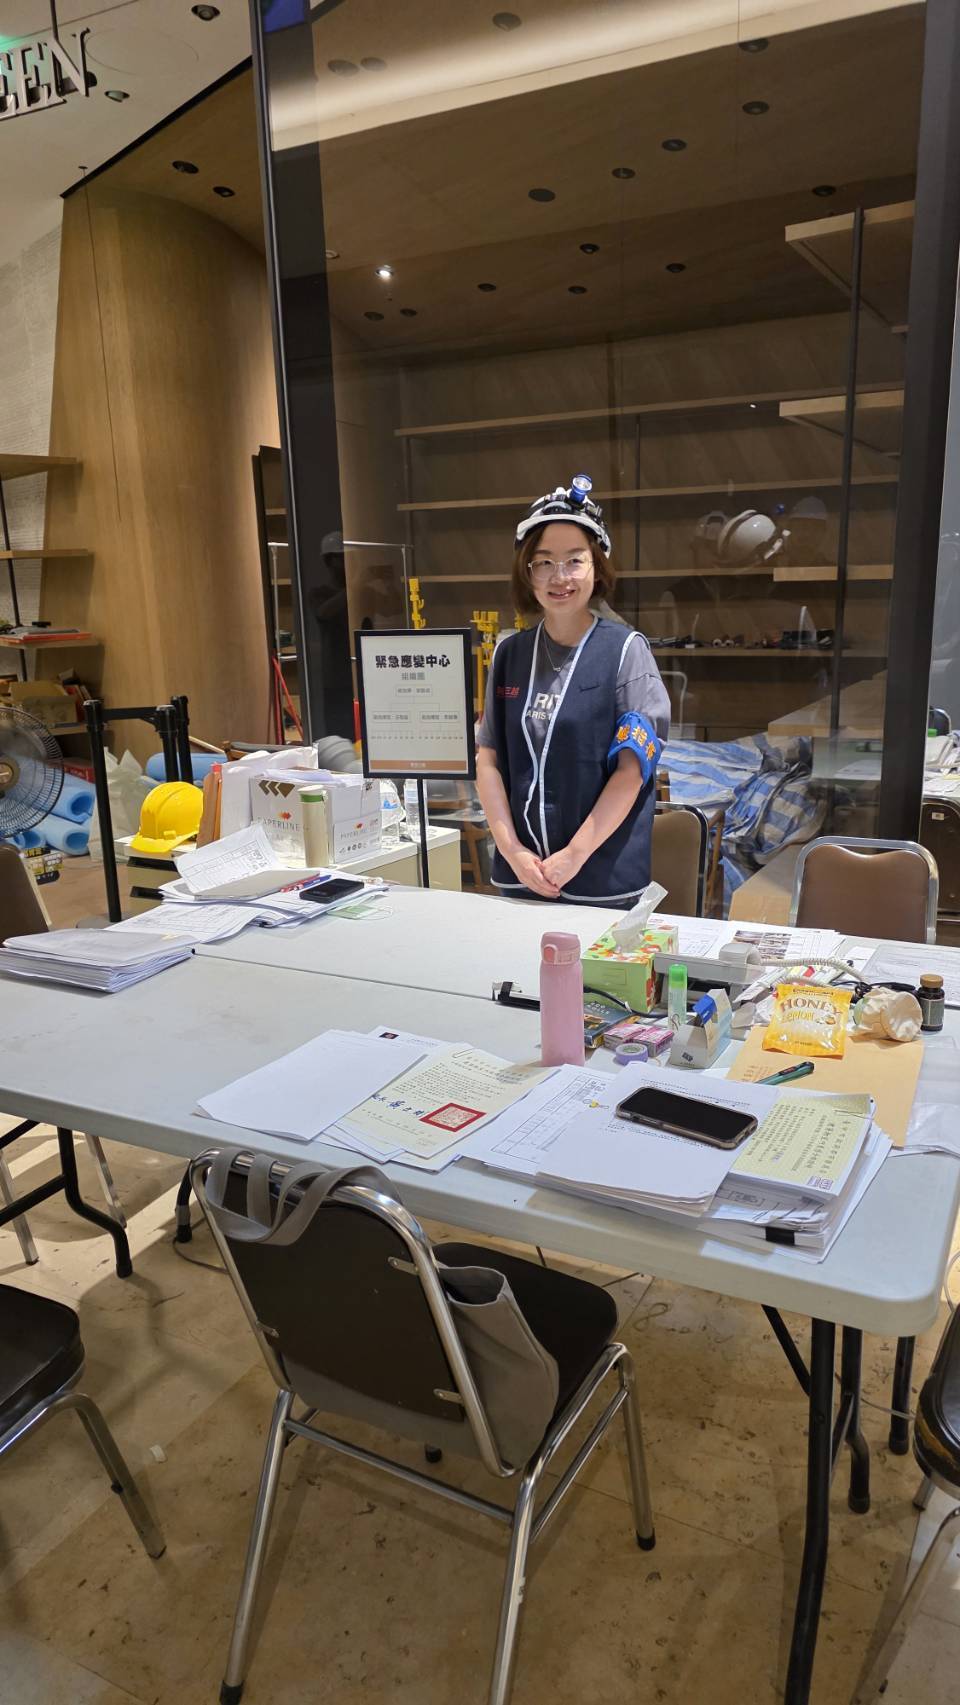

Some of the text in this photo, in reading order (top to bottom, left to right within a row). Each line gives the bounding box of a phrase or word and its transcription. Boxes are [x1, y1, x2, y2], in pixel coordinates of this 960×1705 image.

[375, 654, 451, 668] 緊急應變中心
[780, 997, 843, 1015] HONEY
